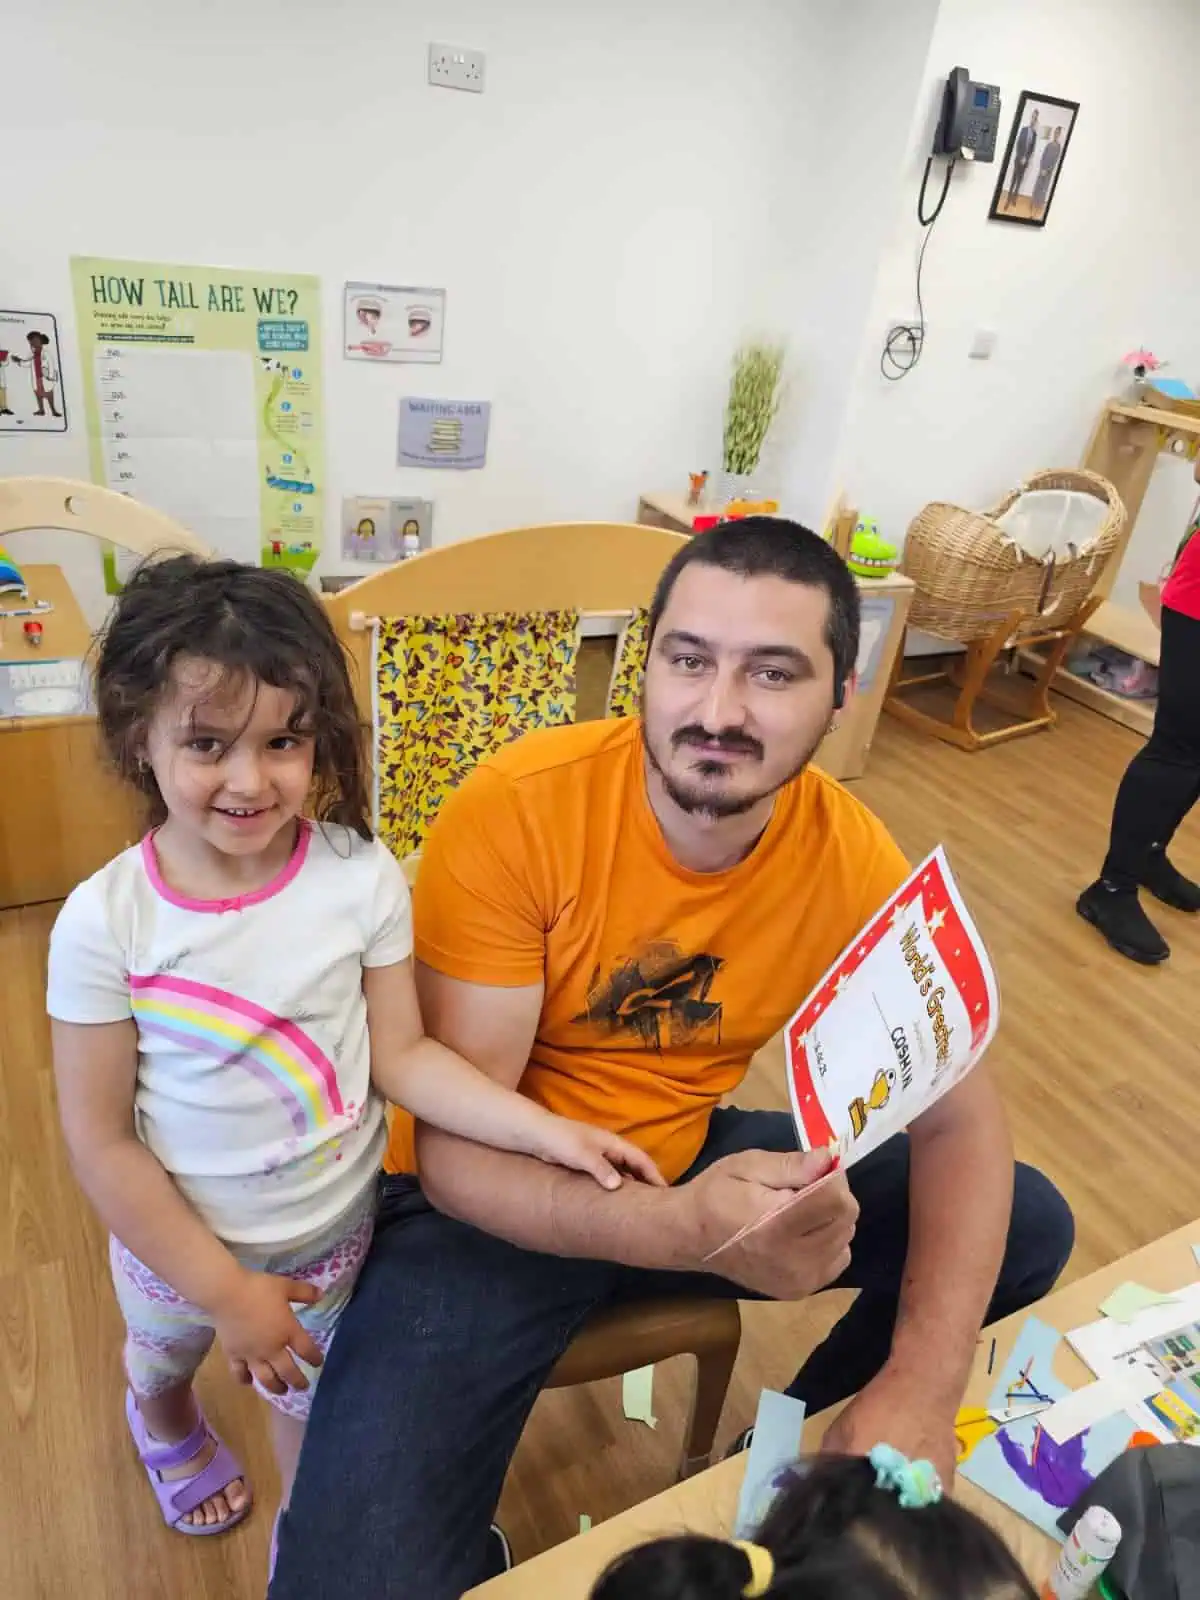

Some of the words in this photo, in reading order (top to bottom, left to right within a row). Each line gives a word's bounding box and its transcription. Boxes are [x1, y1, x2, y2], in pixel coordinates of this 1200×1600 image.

[90, 275, 144, 305] HOW
[153, 279, 199, 309] TALL
[207, 283, 246, 313] ARE
[252, 287, 299, 316] WE?
[899, 921, 937, 997] World's
